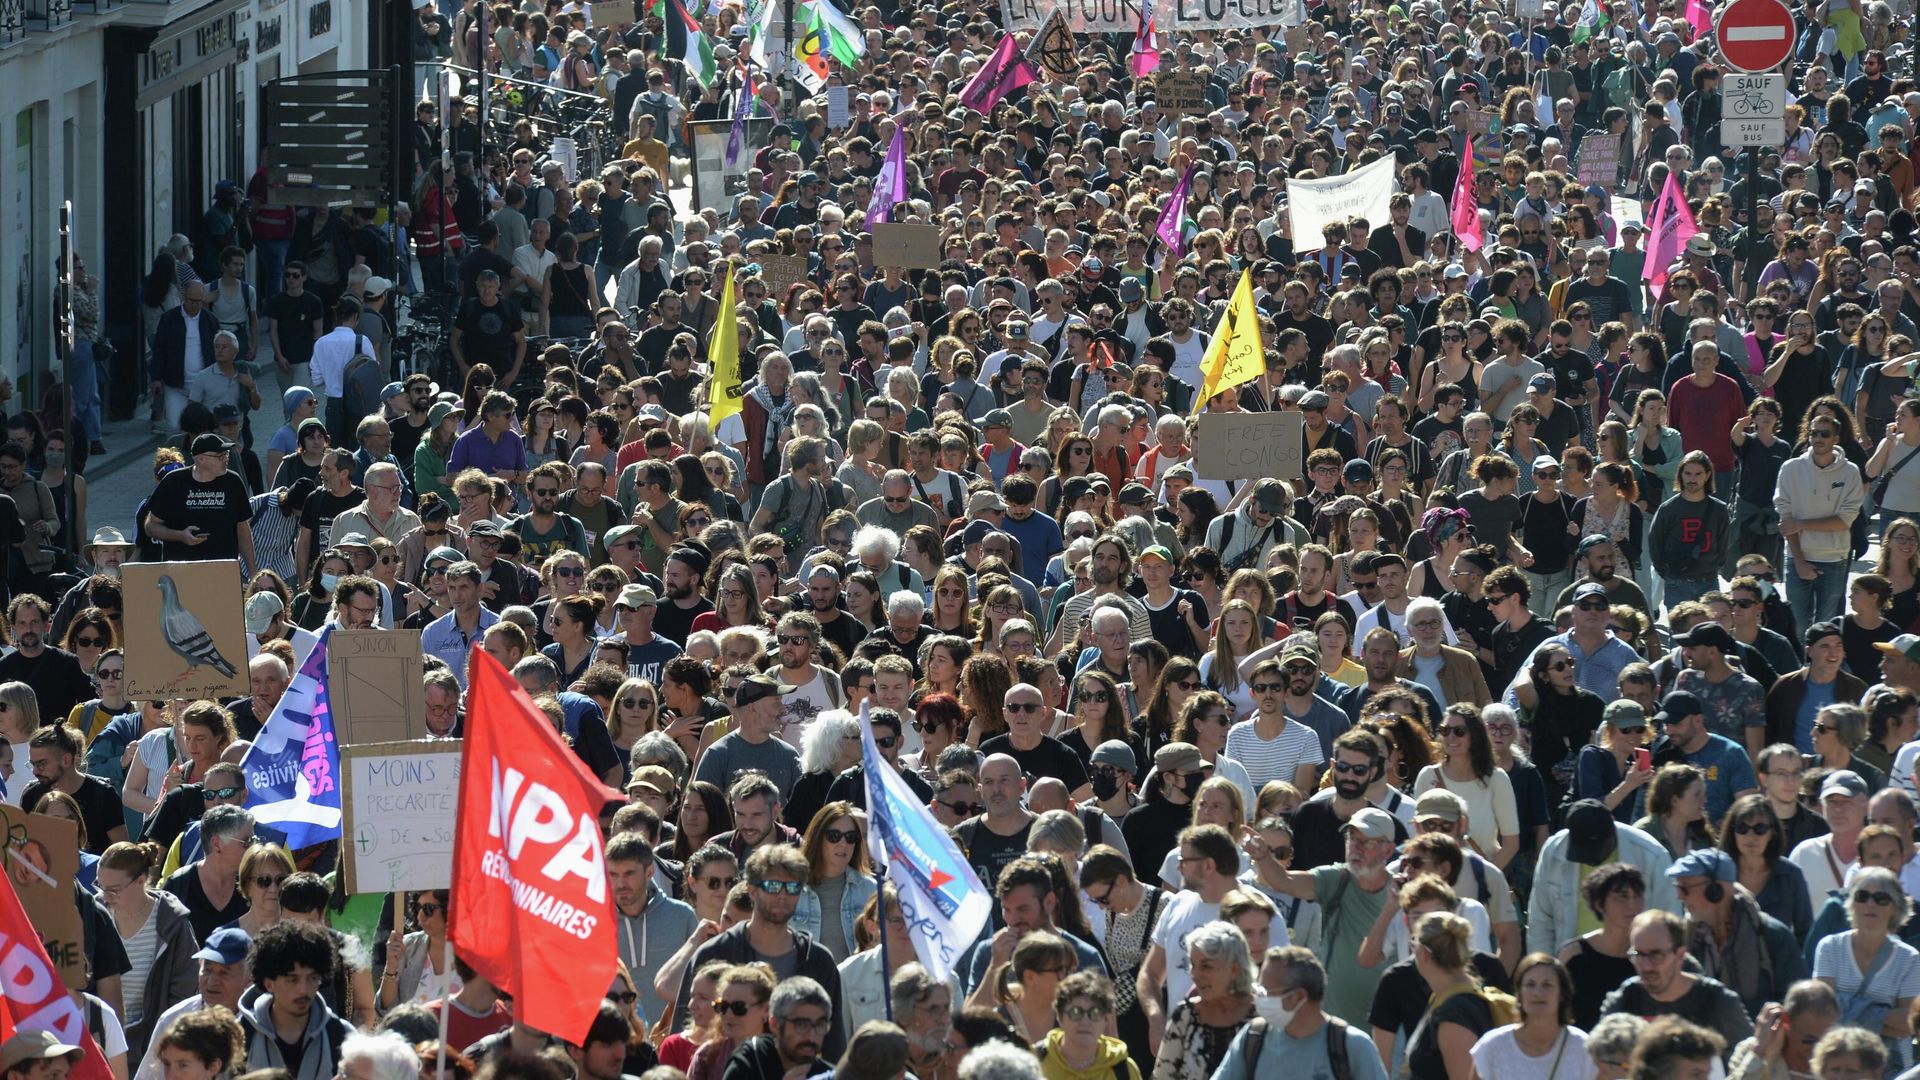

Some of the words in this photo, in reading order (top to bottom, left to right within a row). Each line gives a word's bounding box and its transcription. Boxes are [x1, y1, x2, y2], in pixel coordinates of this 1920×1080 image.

[1737, 79, 1771, 89] SAUF
[1227, 422, 1286, 442] FREE
[1226, 444, 1299, 467] CONGO
[352, 637, 396, 655] SINON
[367, 759, 436, 787] MOINS
[391, 828, 411, 844] DE
